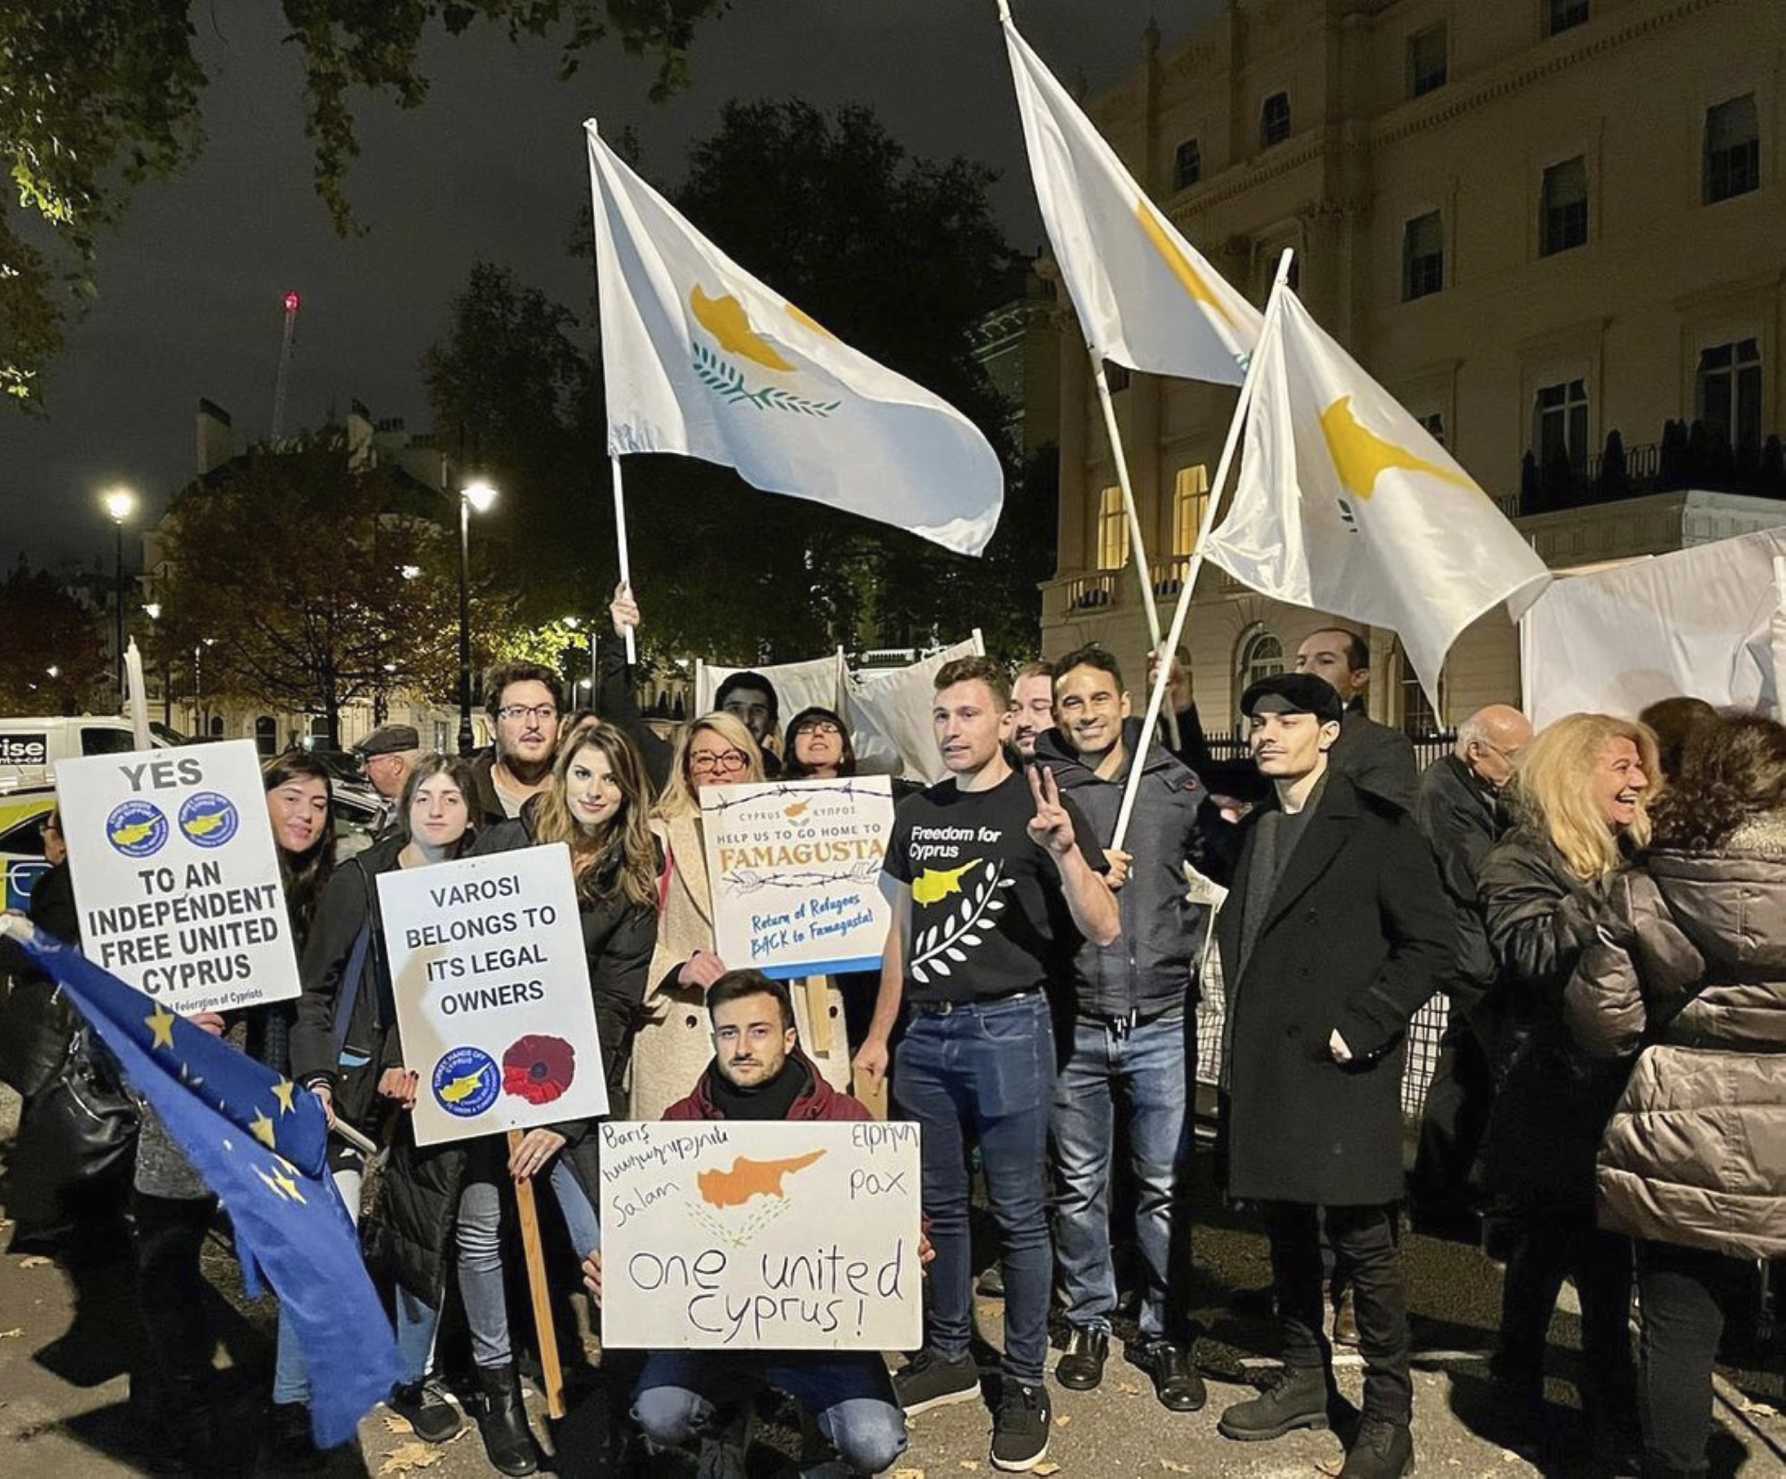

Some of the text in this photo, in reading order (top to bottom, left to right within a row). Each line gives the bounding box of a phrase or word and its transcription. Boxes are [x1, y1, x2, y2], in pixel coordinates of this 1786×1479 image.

[0, 738, 44, 756] ise
[120, 758, 203, 792] YES
[738, 810, 781, 821] CYPRUS
[717, 823, 881, 844] HELP US TO GO HOME TO
[911, 826, 1001, 842] Freedom for
[719, 839, 885, 873] FAMAGUSTA
[909, 843, 959, 860] Cyprus
[138, 860, 221, 895] TO AN
[430, 875, 520, 907] VAROSI
[89, 885, 277, 937] INDEPENDENT
[406, 905, 556, 949] BELONGS TO
[752, 914, 790, 933] Return
[810, 893, 861, 914] Refugees
[100, 916, 278, 968] FREE UNITED
[751, 908, 873, 959] BACK to Famagusta!
[142, 954, 251, 995] CYPRUS
[427, 943, 548, 981] ITS LEGAL
[230, 988, 263, 1004] Cypriots
[441, 980, 544, 1015] OWNERS
[613, 1182, 680, 1227] Salam
[762, 1238, 904, 1300] united
